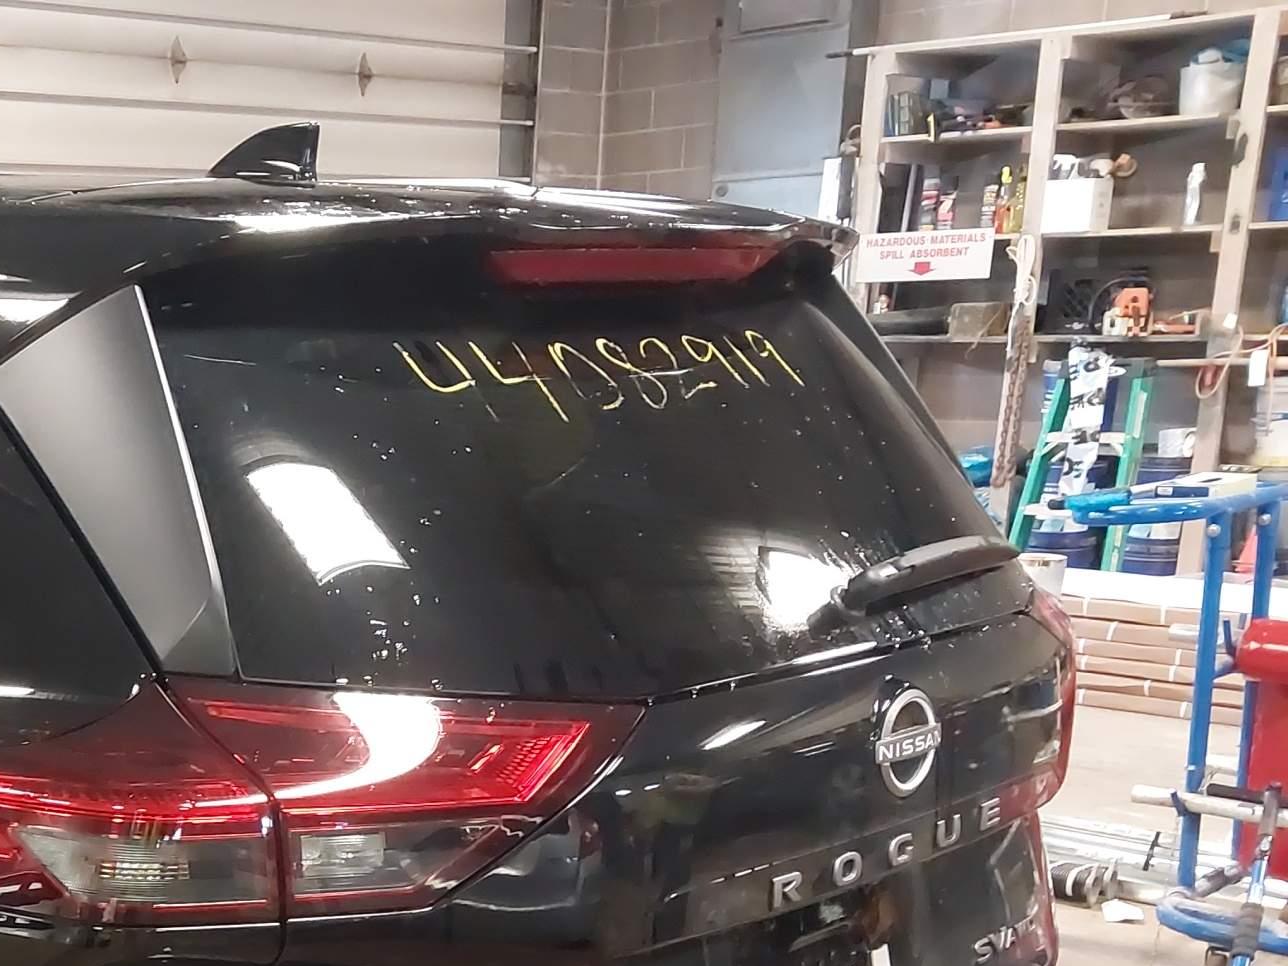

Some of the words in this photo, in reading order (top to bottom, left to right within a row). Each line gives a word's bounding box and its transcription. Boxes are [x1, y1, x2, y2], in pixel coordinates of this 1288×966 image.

[867, 235, 926, 248] HAZARDOUS
[930, 232, 986, 245] MATERIALS
[879, 249, 905, 260] SPILL
[910, 247, 969, 259] ABSORBENT
[392, 329, 806, 423] 44082919
[878, 730, 942, 761] NISSAN
[772, 797, 1001, 909] ROGUE
